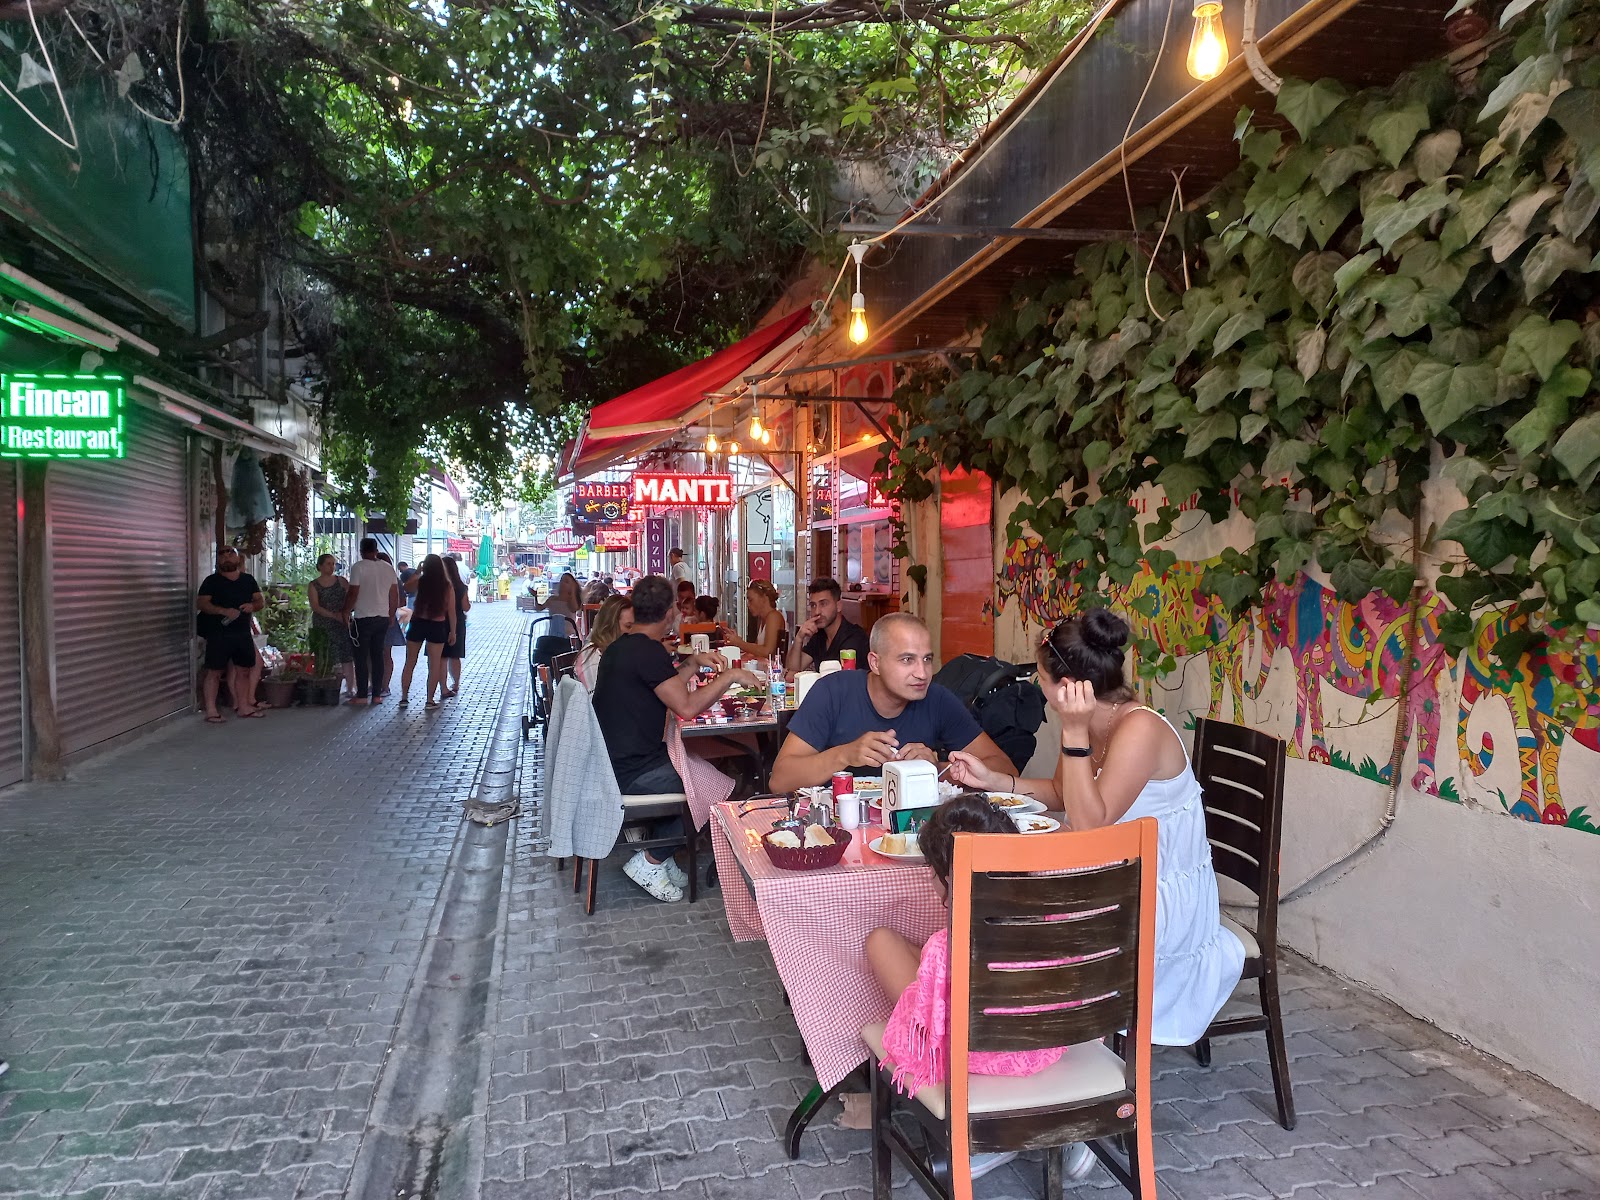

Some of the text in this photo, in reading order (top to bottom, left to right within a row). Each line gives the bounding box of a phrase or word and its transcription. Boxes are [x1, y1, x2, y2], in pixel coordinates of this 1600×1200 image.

[10, 382, 110, 418] Fincan
[8, 426, 118, 449] Restaurant
[579, 485, 627, 497] BARBER
[635, 479, 730, 502] MANTI
[547, 530, 569, 546] GOLDEN
[887, 779, 897, 807] 6
